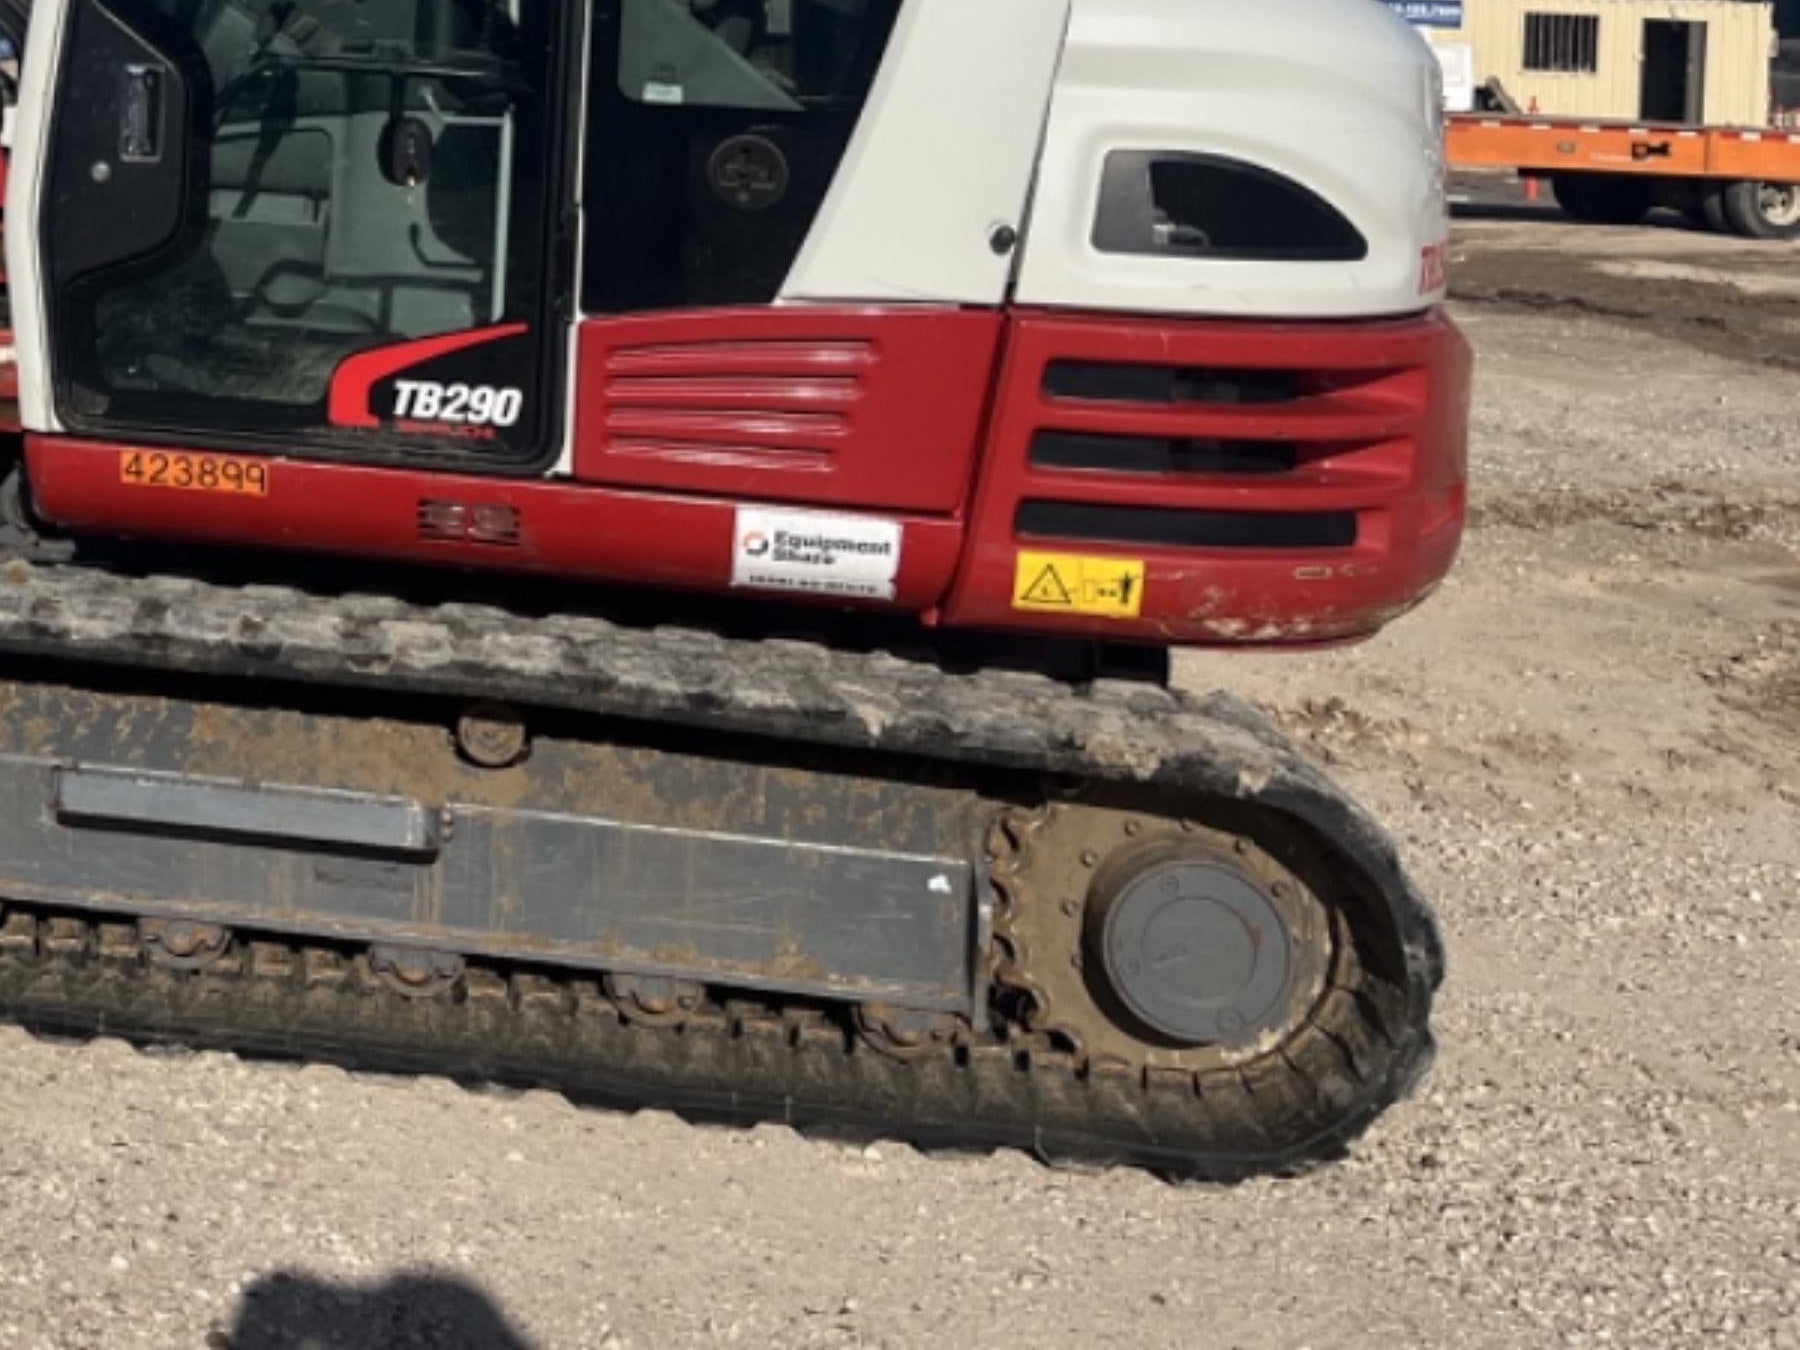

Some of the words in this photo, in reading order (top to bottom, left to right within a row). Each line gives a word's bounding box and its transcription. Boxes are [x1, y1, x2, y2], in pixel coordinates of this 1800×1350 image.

[393, 379, 522, 426] TB290
[125, 452, 265, 492] 423899
[773, 530, 891, 555] Equipment
